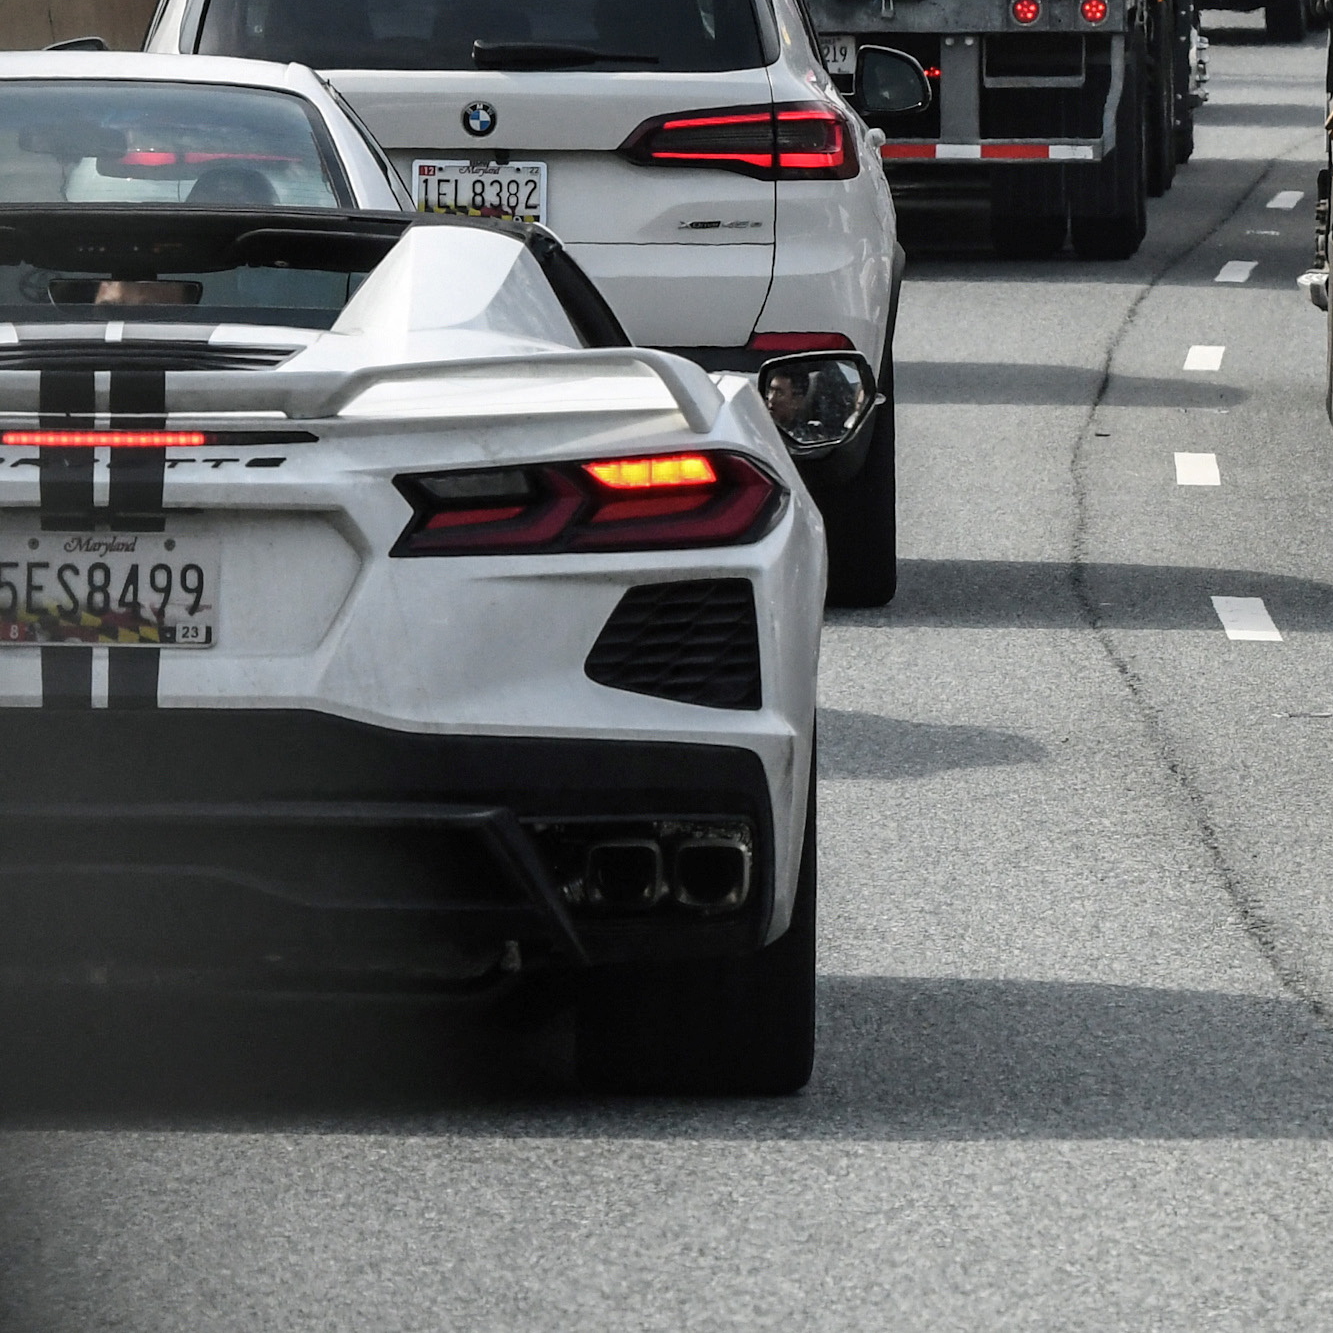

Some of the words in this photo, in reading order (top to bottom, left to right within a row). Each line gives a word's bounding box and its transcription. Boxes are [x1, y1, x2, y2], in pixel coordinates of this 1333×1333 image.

[459, 166, 501, 177] Maryland
[422, 178, 539, 210] 1EL8382
[63, 535, 138, 558] Maryland
[0, 561, 204, 616] 5ES8499
[181, 626, 199, 639] 23
